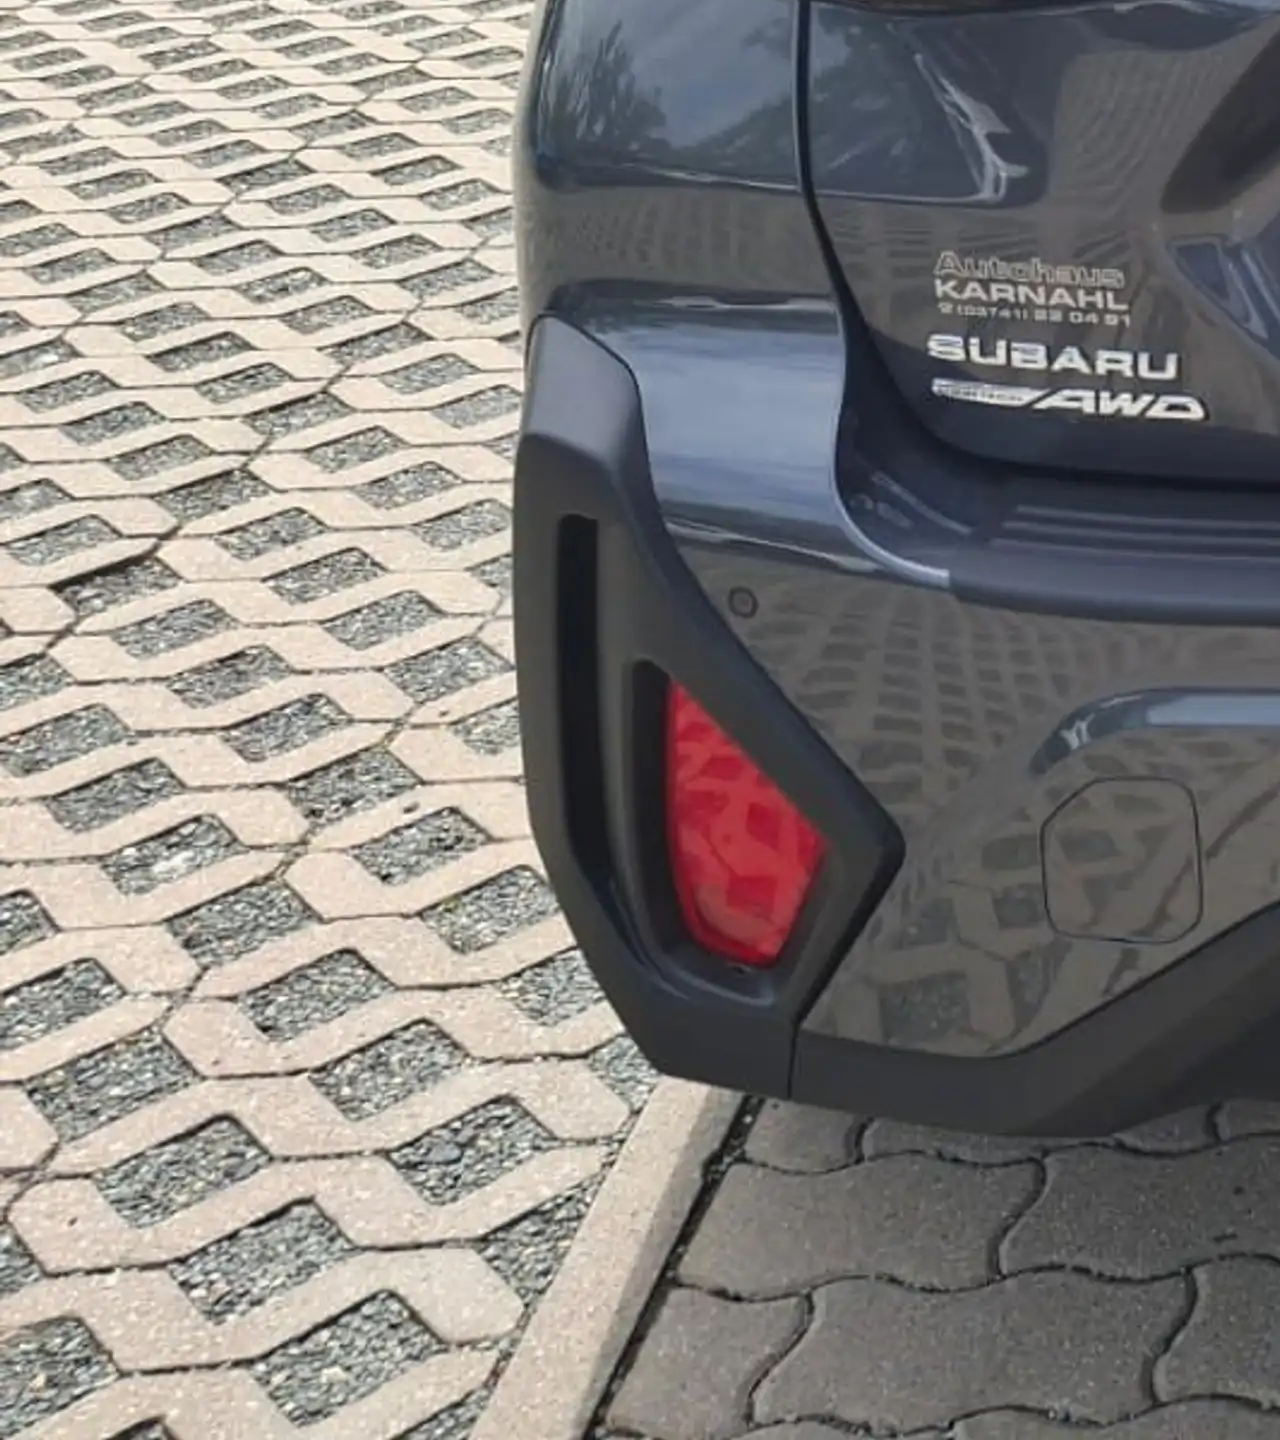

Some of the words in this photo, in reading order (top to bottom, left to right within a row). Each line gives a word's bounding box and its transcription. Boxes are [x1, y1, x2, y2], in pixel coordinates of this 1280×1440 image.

[934, 250, 1124, 289] Autohaus
[935, 279, 1129, 311] KARNAHL
[1033, 308, 1063, 324] 22
[1070, 312, 1099, 325] 04
[1104, 314, 1131, 328] 91
[927, 333, 1179, 380] SUBARU
[1032, 389, 1207, 421] AWD
